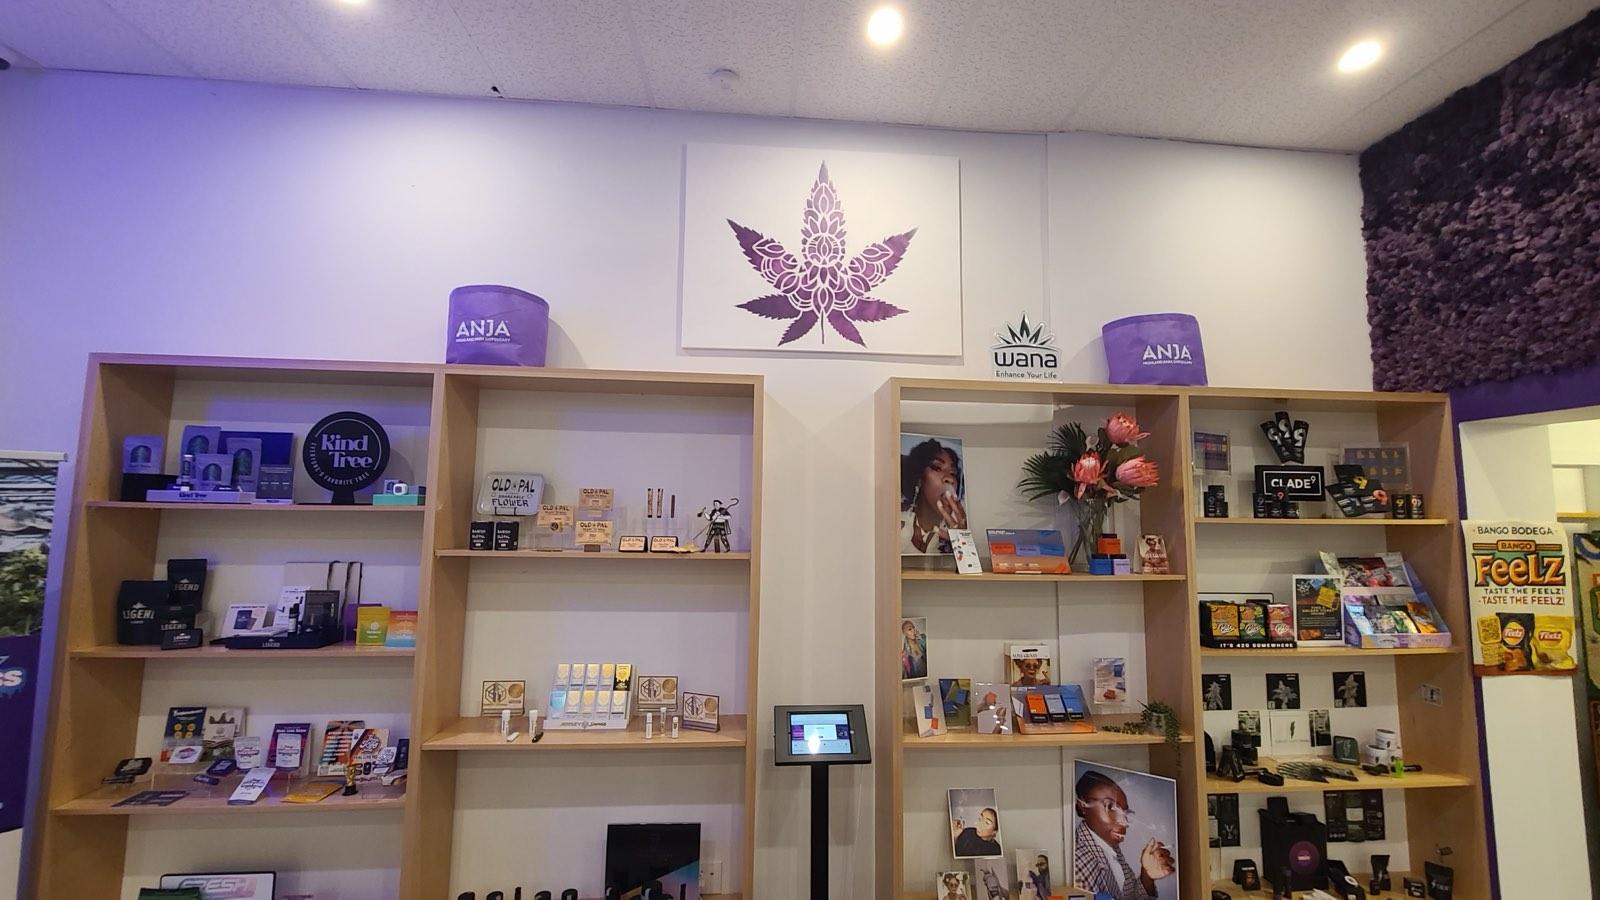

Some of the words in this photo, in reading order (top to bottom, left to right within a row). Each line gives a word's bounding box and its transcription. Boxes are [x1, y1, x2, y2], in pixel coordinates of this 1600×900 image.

[455, 319, 511, 338] ANJA
[1142, 343, 1192, 361] ANJA
[994, 351, 1057, 368] wana
[995, 370, 1025, 378] Enhance
[1043, 371, 1057, 379] Life
[320, 433, 369, 451] Kind
[328, 451, 373, 468] Tree
[491, 478, 512, 492] OLD
[517, 479, 536, 493] PAL
[491, 498, 530, 508] FLOWER
[1477, 526, 1509, 535] BANGO
[1511, 526, 1554, 535] BODEGA
[1500, 542, 1532, 550] BANGO
[1484, 587, 1509, 595] TASTE
[1511, 587, 1528, 595] THE
[1481, 595, 1508, 604] TASTE
[1509, 596, 1528, 605] THE
